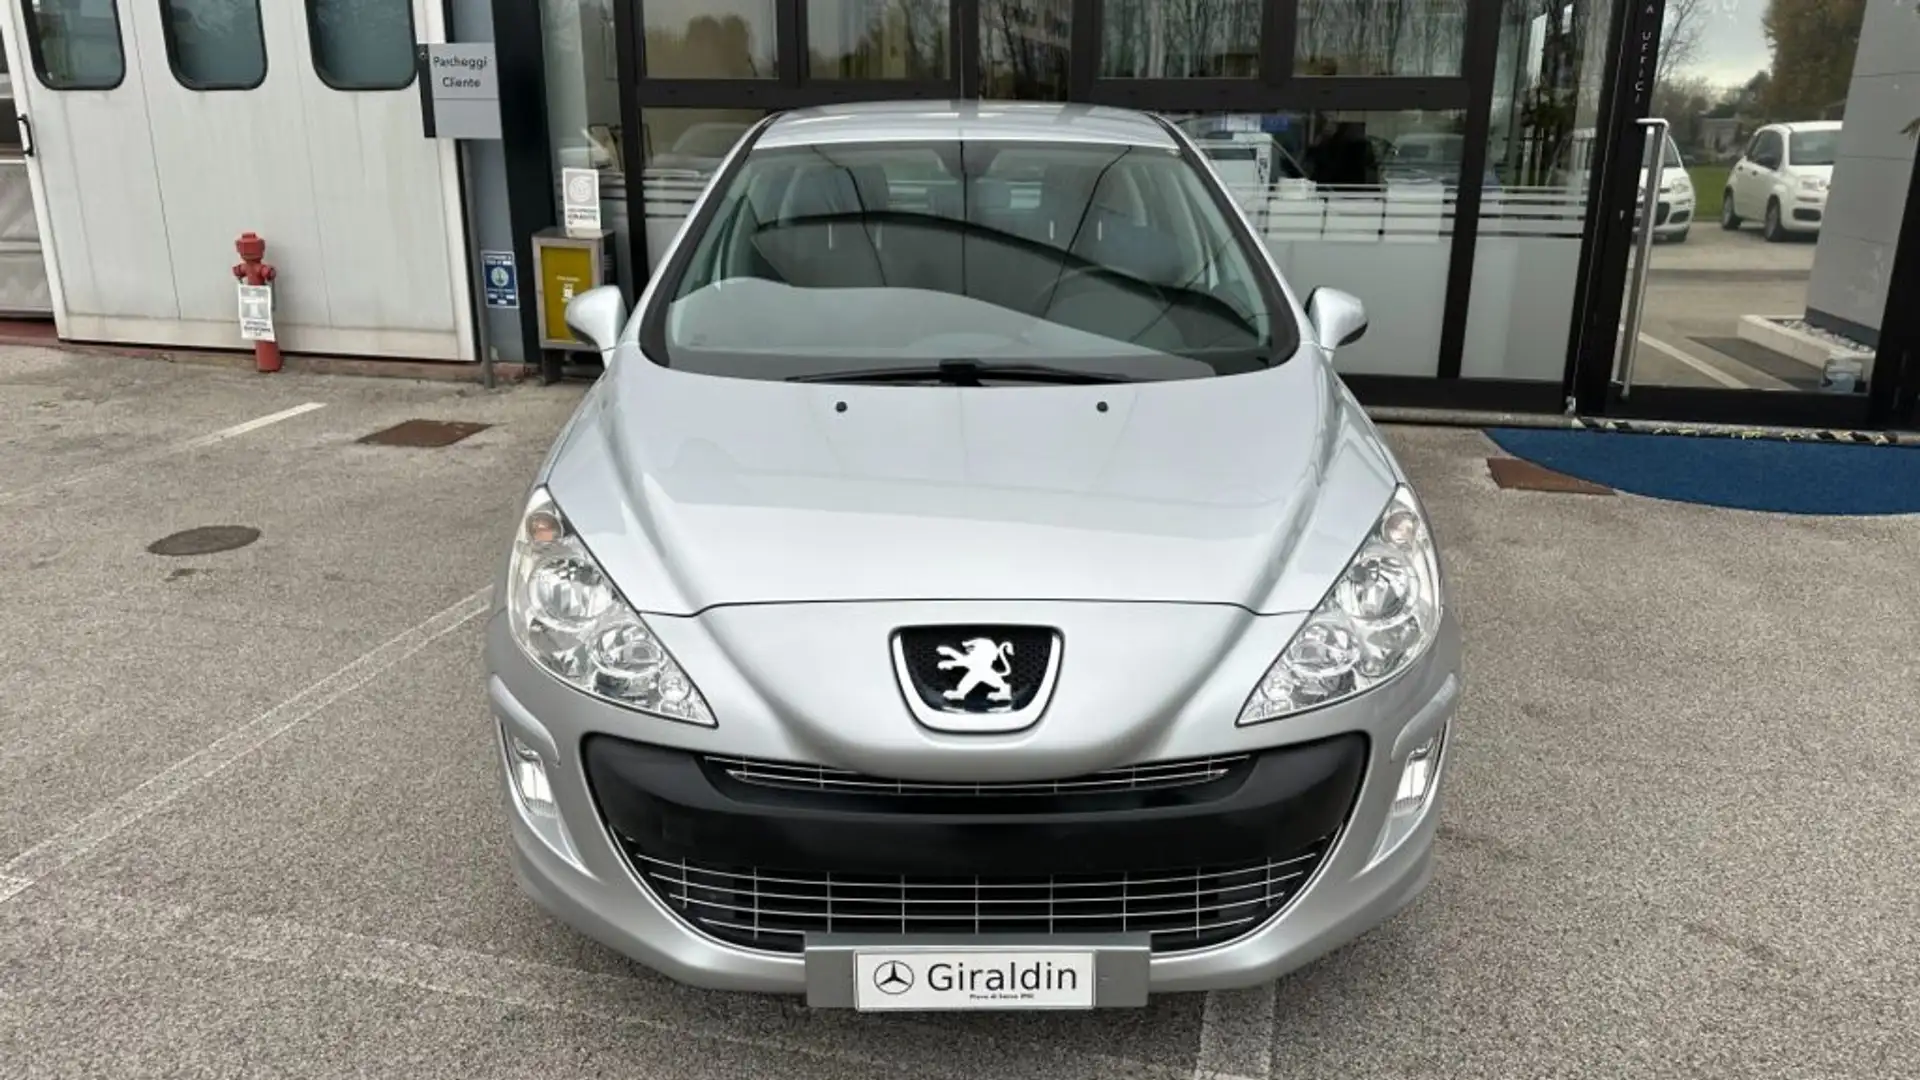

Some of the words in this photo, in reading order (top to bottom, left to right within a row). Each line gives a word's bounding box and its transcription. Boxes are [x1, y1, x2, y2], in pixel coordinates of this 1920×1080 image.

[433, 55, 488, 70] Parcheggi
[1635, 31, 1652, 104] UFFICI
[442, 76, 482, 88] Cliente
[927, 961, 1077, 991] Giraldin
